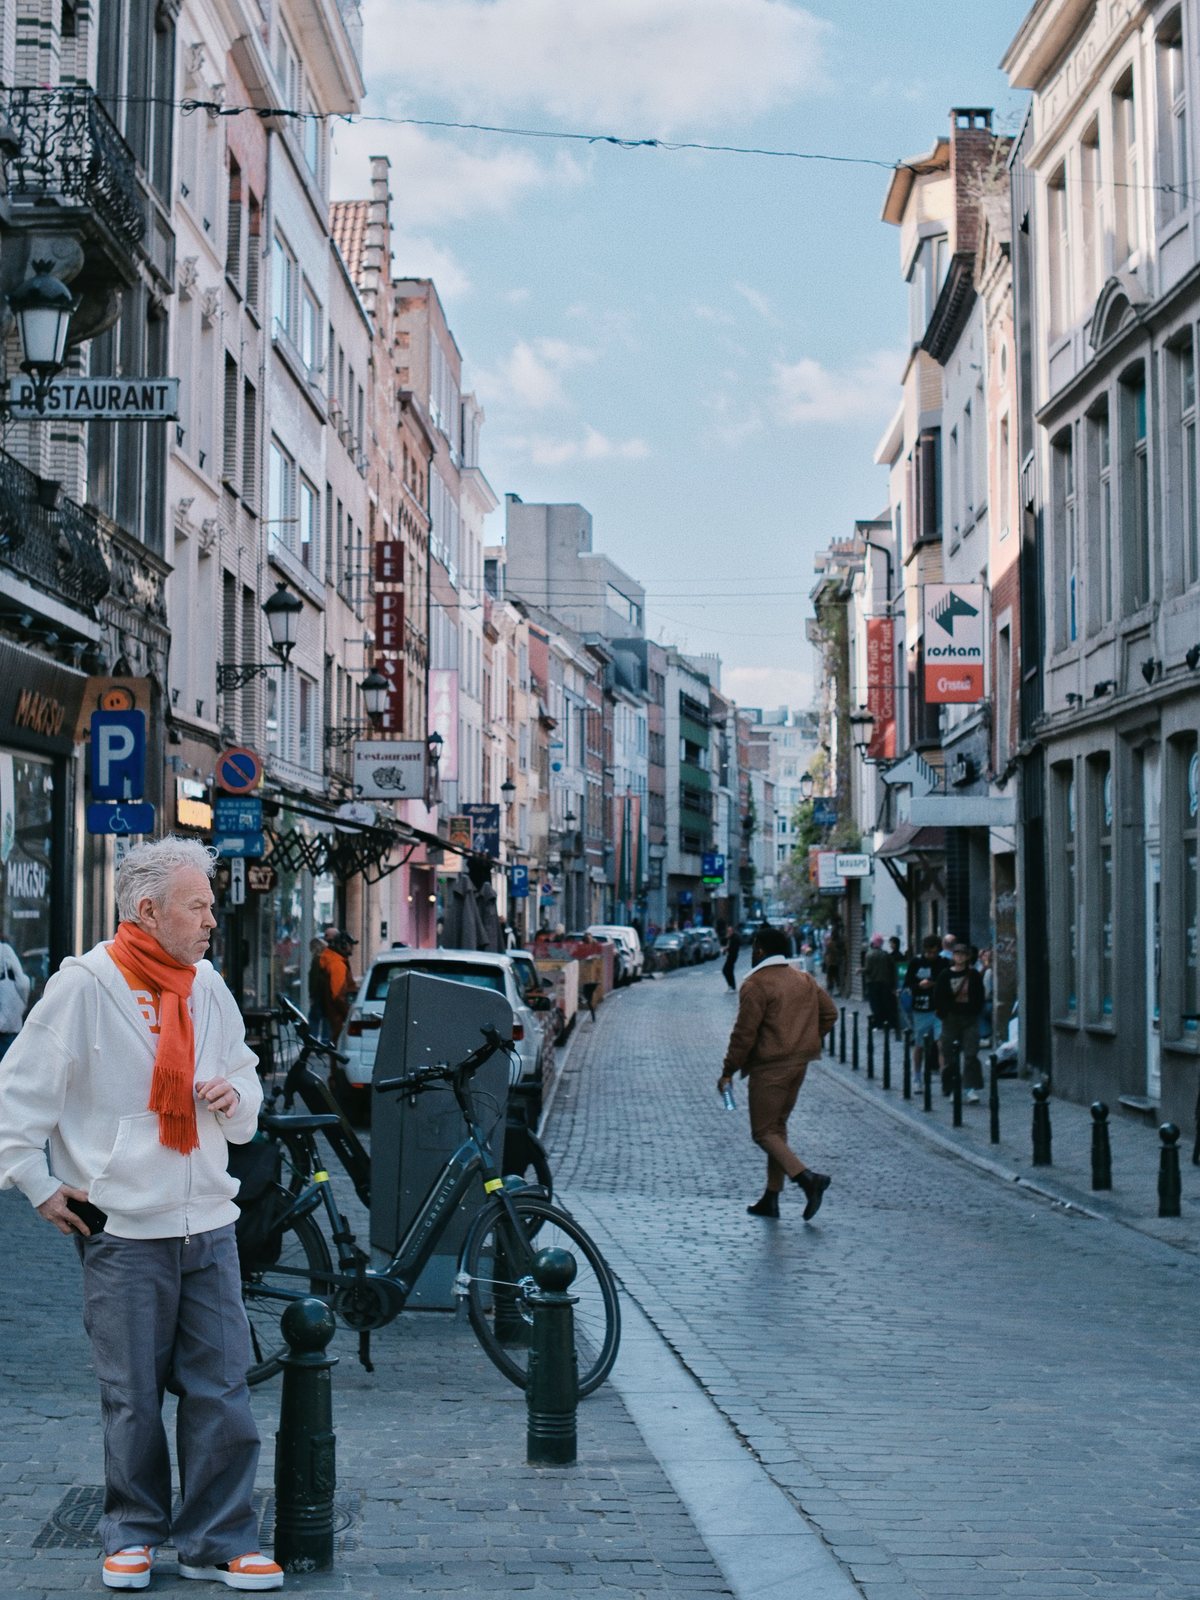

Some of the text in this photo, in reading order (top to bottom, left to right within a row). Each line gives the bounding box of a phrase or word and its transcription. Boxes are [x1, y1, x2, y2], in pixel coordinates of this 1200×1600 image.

[20, 385, 169, 410] RSTAURANT
[927, 644, 981, 657] roskam
[98, 724, 136, 787] P
[715, 857, 724, 870] P
[514, 868, 526, 885] P
